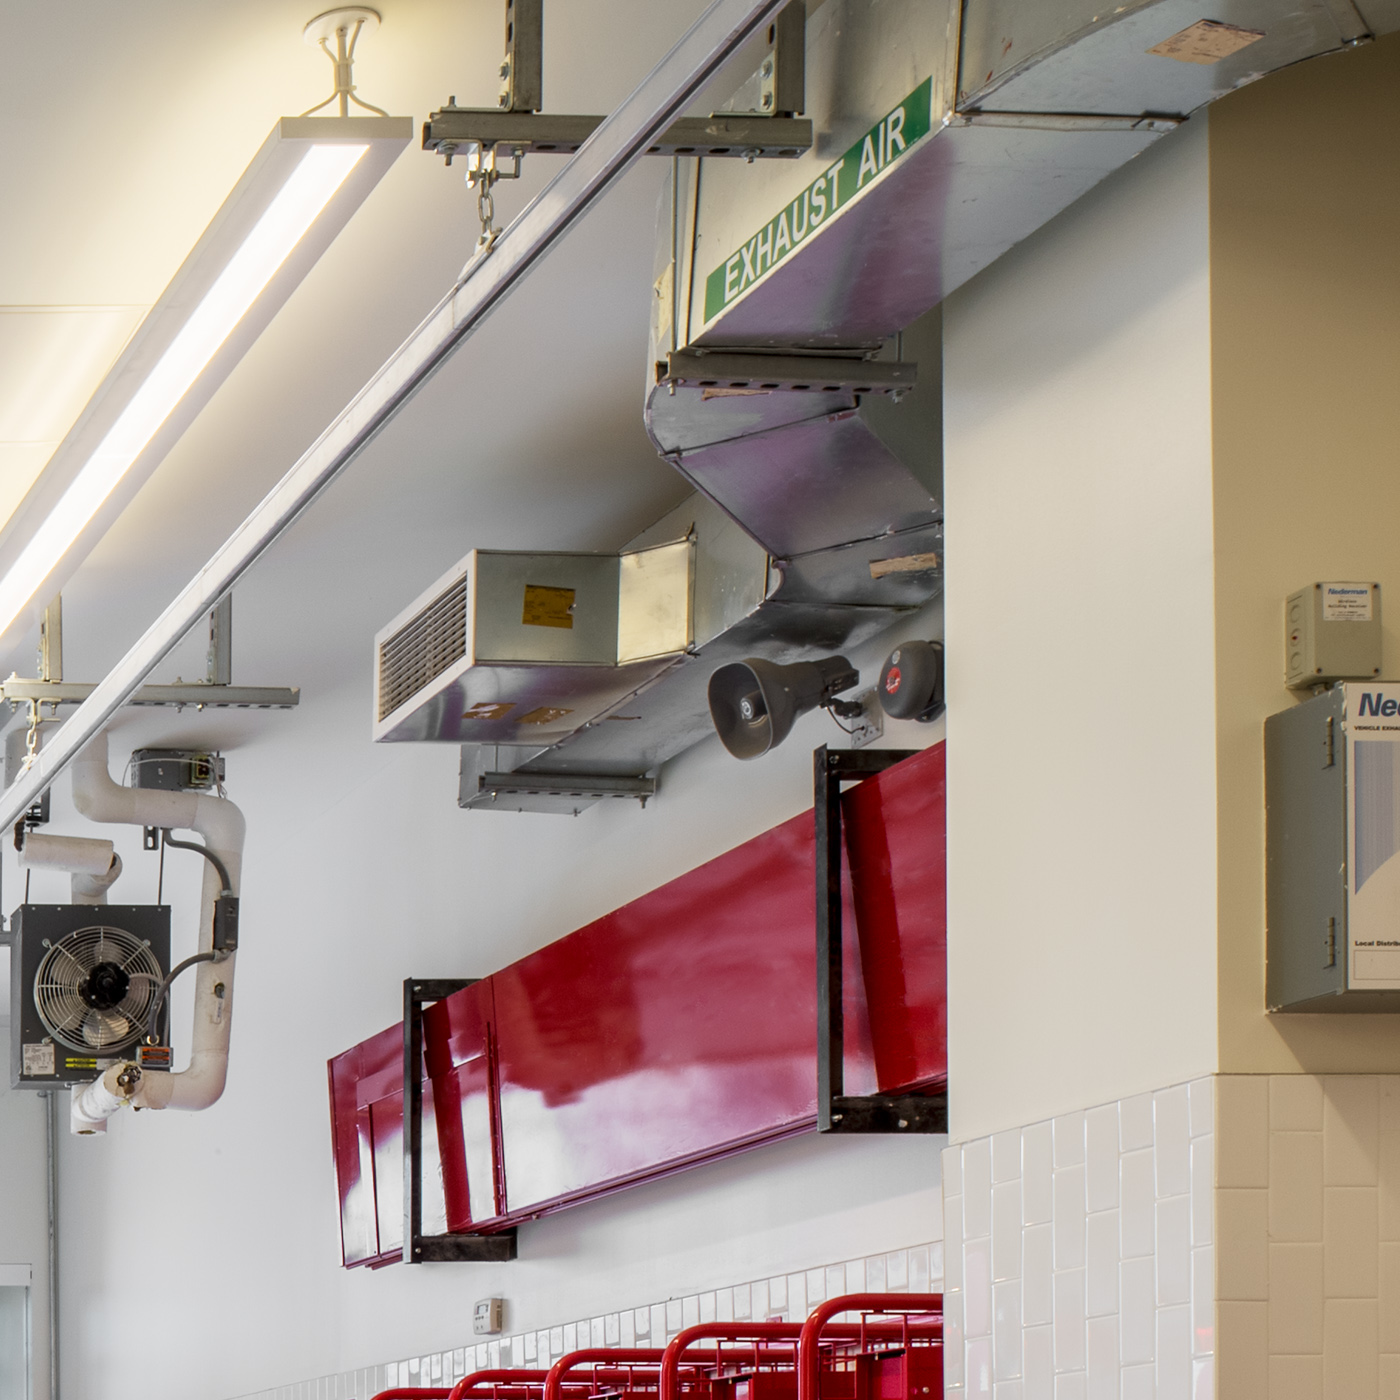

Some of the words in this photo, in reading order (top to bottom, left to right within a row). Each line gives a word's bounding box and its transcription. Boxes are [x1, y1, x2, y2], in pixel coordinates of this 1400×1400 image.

[724, 158, 845, 304] EXHAUST
[857, 105, 908, 189] AIR
[1358, 692, 1400, 717] Ne
